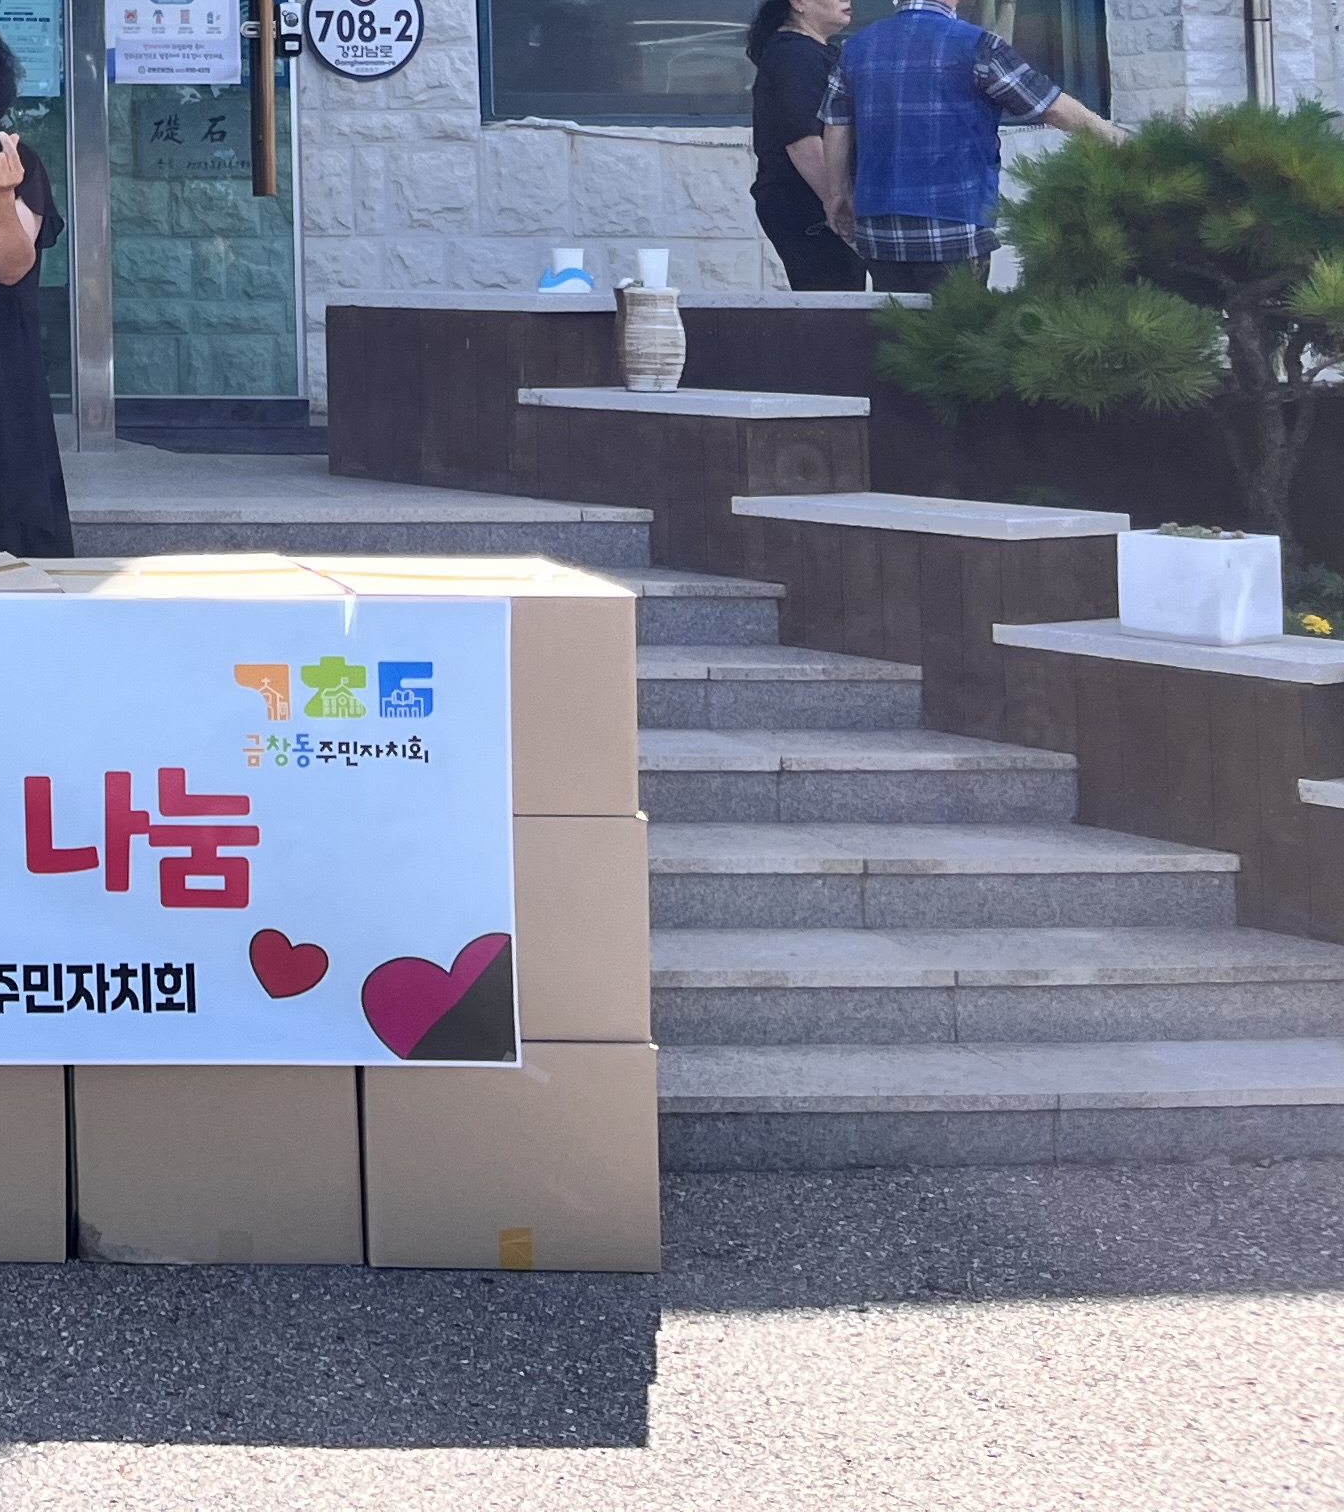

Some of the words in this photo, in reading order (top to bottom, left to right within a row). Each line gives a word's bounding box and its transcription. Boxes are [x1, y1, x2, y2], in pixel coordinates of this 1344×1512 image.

[315, 9, 413, 42] 708-2
[336, 45, 393, 58] 강화남로
[24, 767, 260, 909] 나눔
